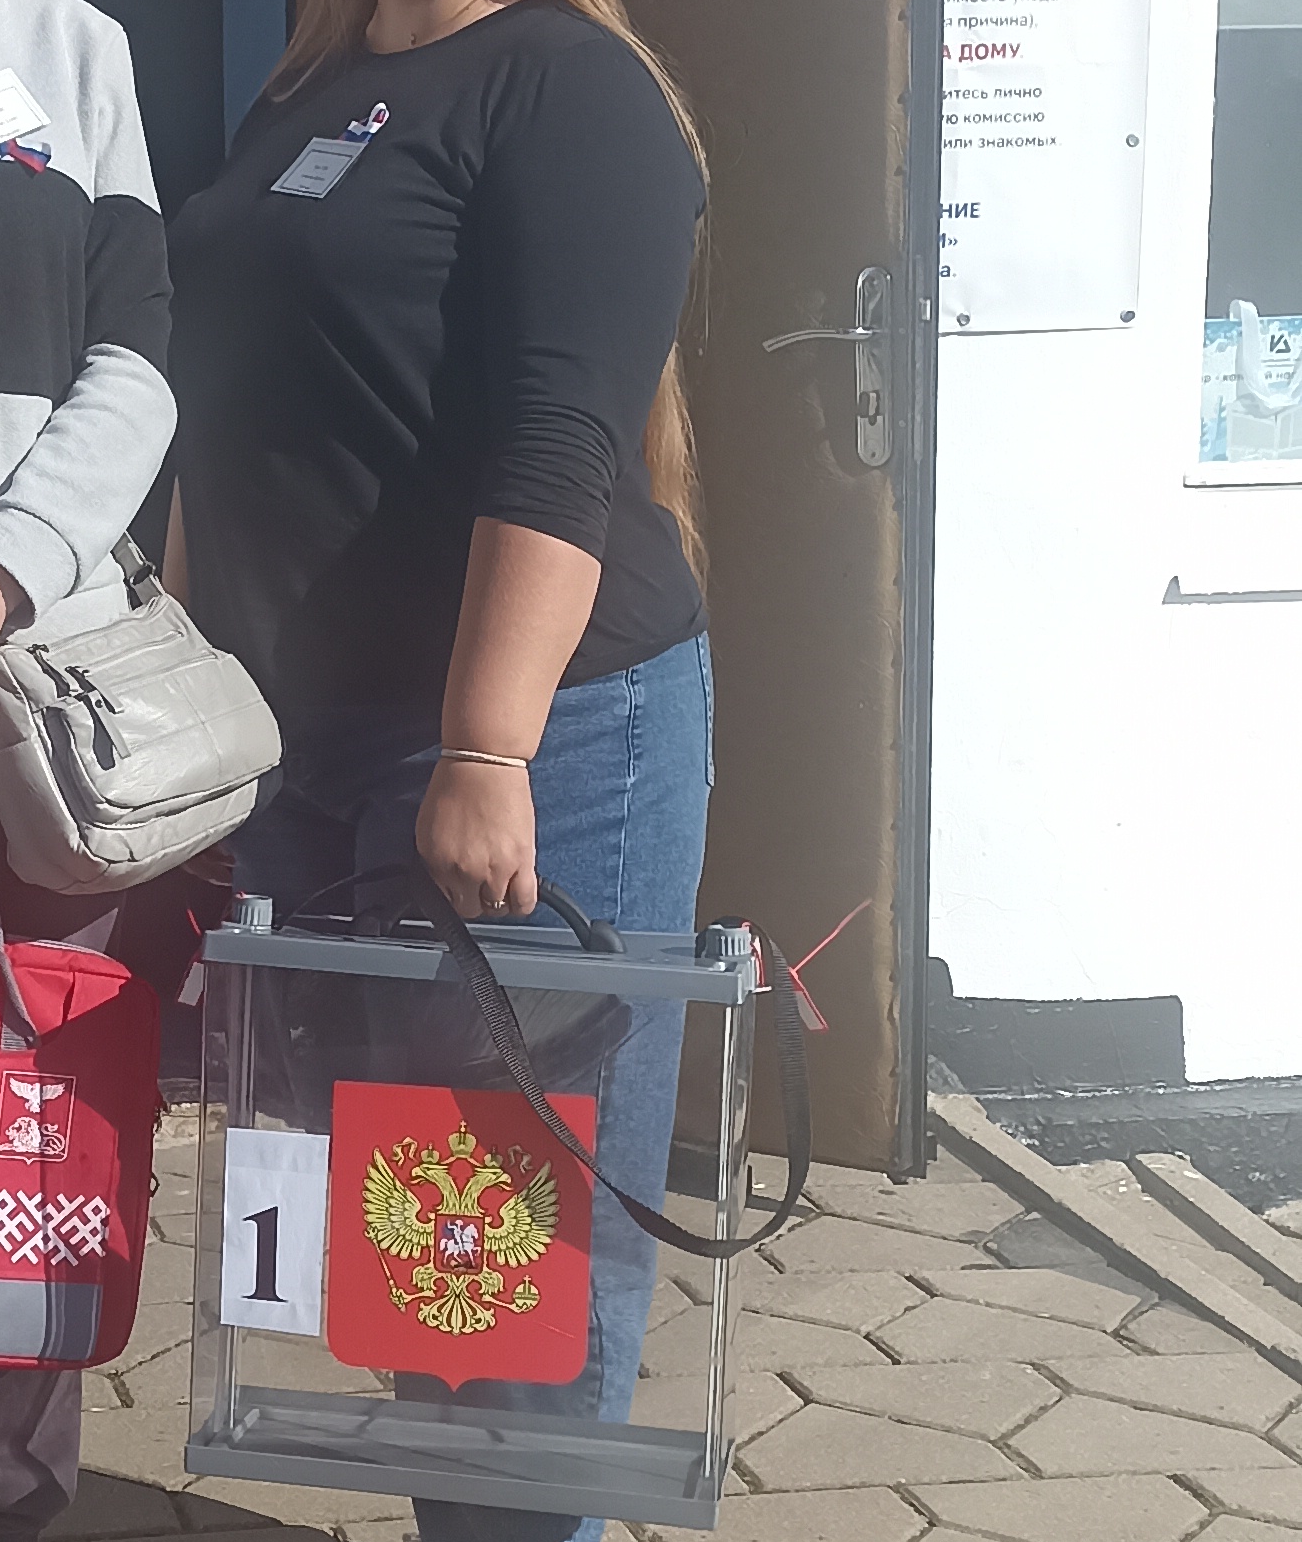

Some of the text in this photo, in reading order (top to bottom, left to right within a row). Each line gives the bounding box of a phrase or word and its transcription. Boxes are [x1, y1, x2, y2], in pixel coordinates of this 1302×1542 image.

[993, 87, 1043, 100] лично
[942, 111, 1045, 125] ю комиссию
[943, 137, 973, 149] или
[240, 1205, 289, 1303] 1
